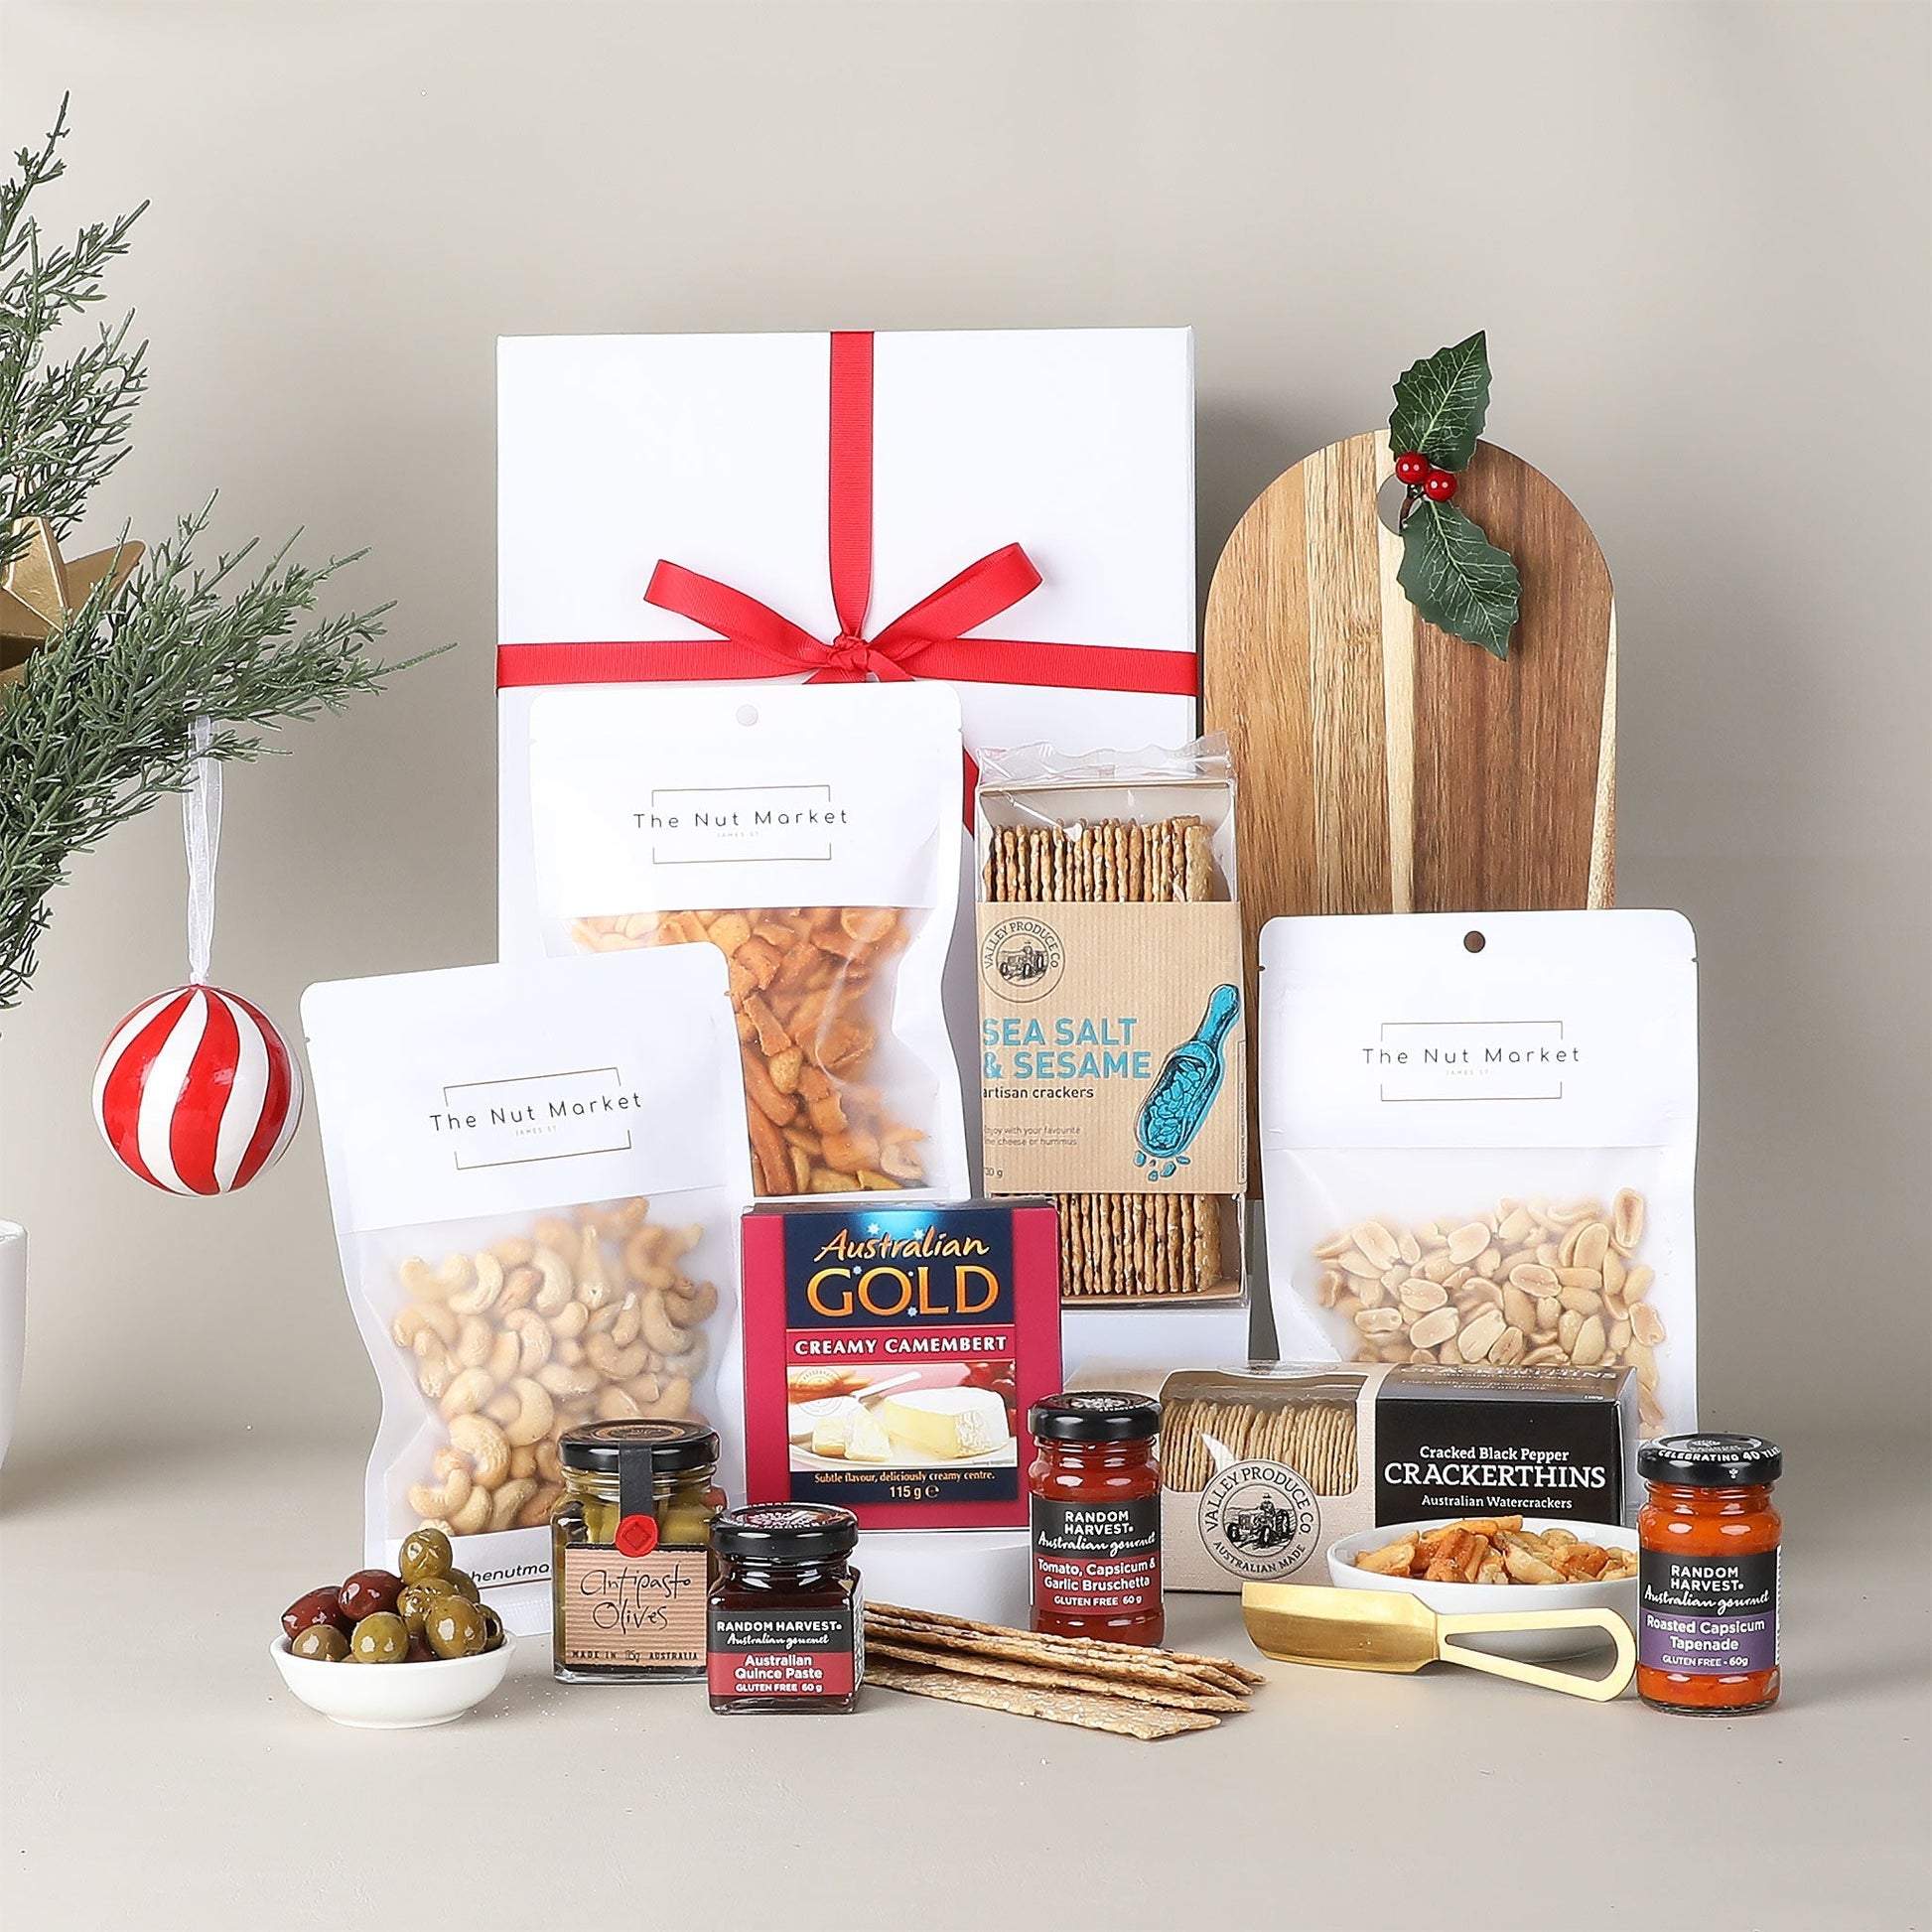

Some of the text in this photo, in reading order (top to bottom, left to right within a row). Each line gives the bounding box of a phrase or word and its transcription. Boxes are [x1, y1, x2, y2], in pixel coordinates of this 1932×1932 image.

[633, 809, 848, 828] The Nut Market
[984, 925, 1009, 969] VALLEY
[1009, 921, 1058, 952] PRODUCE
[982, 1018, 1137, 1045] SEA SALT
[1362, 1047, 1580, 1064] The Nut Market
[984, 1051, 1152, 1079] & SESAME
[983, 1086, 1094, 1099] artisan crackers
[429, 1092, 641, 1131] The Nut Market
[813, 1224, 990, 1262] Australian
[806, 1265, 1000, 1317] GOLD
[794, 1336, 1007, 1355] CREAMY CAMEMBERT
[1420, 1447, 1570, 1464] Cracked Black Pepper
[1658, 1449, 1738, 1462] CELEBRATING
[1742, 1450, 1760, 1461] 40
[814, 1470, 995, 1484] Subtle flavour, deliciously creamy centre.
[1384, 1463, 1606, 1488] CRACKERTHINS
[890, 1485, 910, 1498] 115
[913, 1488, 921, 1500] g
[1204, 1466, 1313, 1535] VALLEY PRODUCE CO.
[1421, 1495, 1573, 1509] Australian Watercrackers
[1064, 1510, 1129, 1523] RANDOM
[1037, 1530, 1156, 1557] Australian gourmet
[1213, 1541, 1306, 1573] AUSTRALIAN MADE
[472, 1564, 550, 1582] henutma
[1037, 1557, 1157, 1577] Tomato, Capsicum &
[1671, 1565, 1738, 1579] RANDOM
[1044, 1576, 1150, 1591] Garlic Bruschetta
[1053, 1595, 1091, 1605] GLUTEN
[1093, 1596, 1119, 1605] FREE
[1122, 1595, 1135, 1604] 60
[1644, 1585, 1770, 1615] Australian gourmet
[593, 1597, 669, 1634] Olives
[717, 1621, 773, 1632] RANDOM
[1647, 1614, 1765, 1636] Roasted Capsicum
[727, 1633, 829, 1649] Australian gourmet
[1670, 1635, 1739, 1651] Tapenade
[572, 1650, 600, 1659] MADE
[648, 1651, 698, 1660] AUSTRALIA
[745, 1654, 812, 1666] Australian
[1662, 1654, 1698, 1666] GLUTEN
[1698, 1657, 1722, 1666] FREE
[1728, 1656, 1748, 1667] 60g
[735, 1668, 823, 1680] Quince Paste
[736, 1683, 773, 1693] GLUTEN
[774, 1683, 798, 1692] FREE
[801, 1683, 814, 1692] 60
